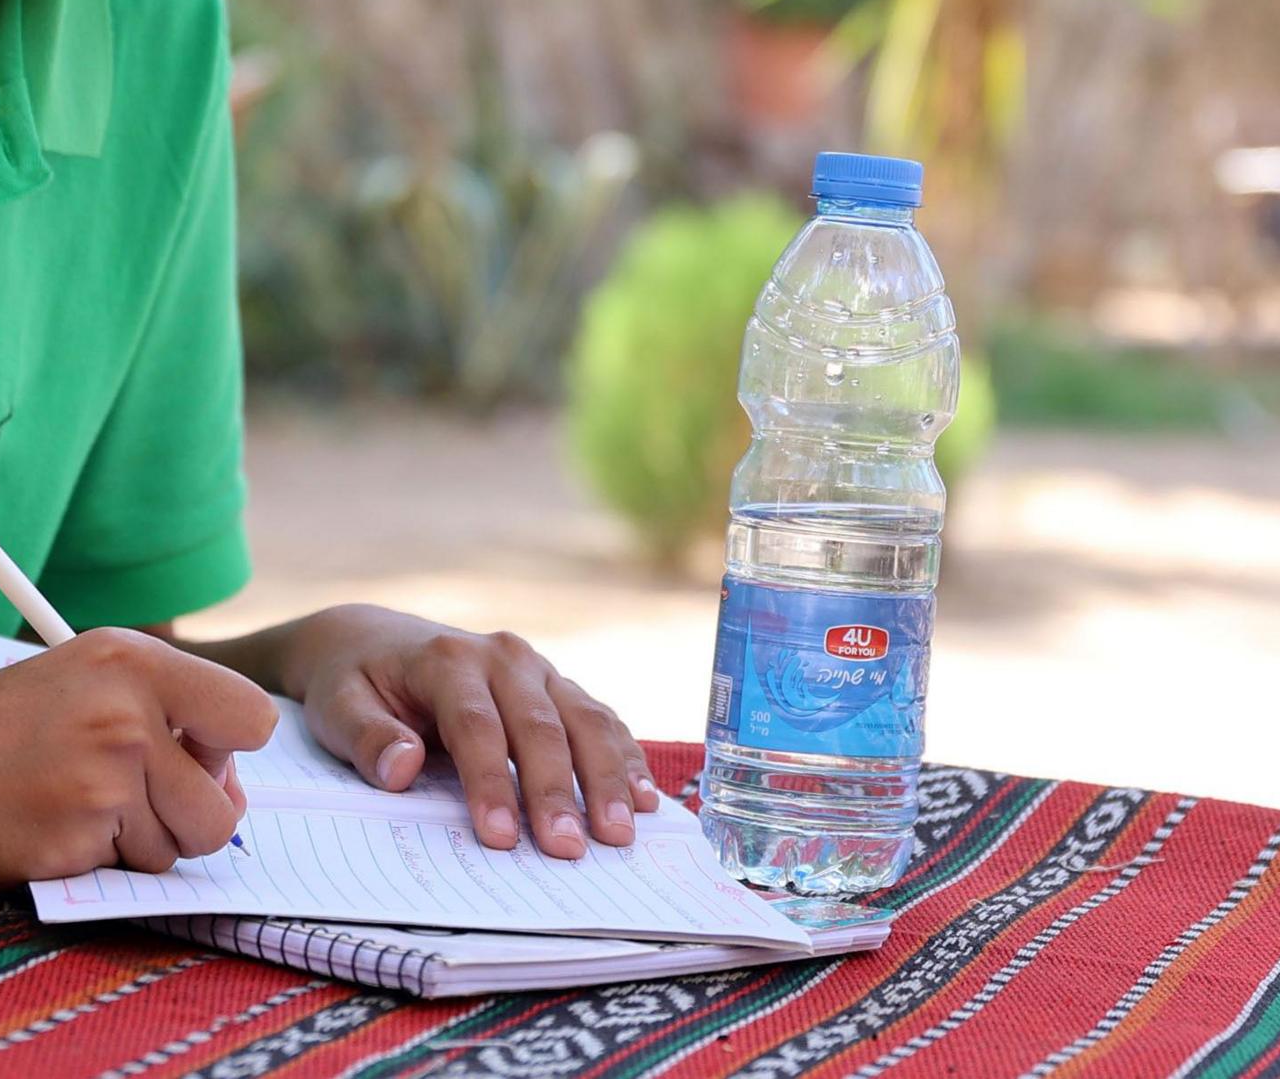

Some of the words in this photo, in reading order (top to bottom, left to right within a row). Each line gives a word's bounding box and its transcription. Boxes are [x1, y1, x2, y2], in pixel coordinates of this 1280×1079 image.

[842, 628, 872, 647] 4U
[838, 646, 859, 656] FOR
[858, 647, 876, 657] YOU
[816, 668, 865, 689] שתייה
[750, 710, 771, 724] 500
